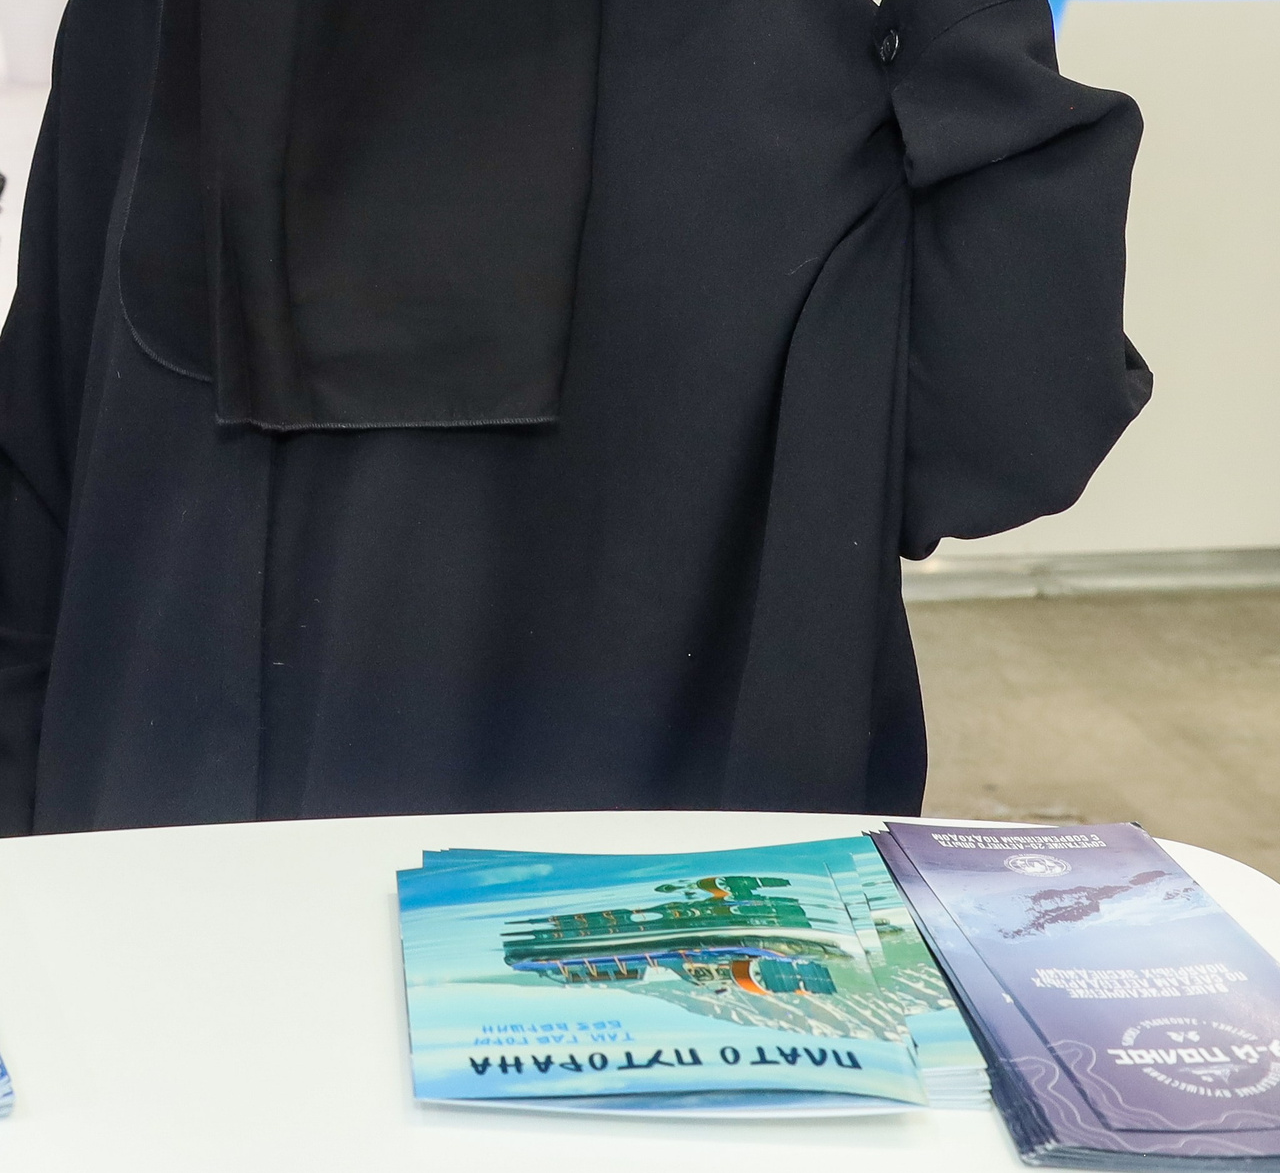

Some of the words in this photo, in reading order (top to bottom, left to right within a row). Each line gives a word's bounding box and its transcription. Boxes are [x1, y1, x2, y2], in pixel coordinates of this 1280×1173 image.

[931, 832, 997, 842] ПОДХОДОМ
[1153, 974, 1224, 988] СЛЕДАМ
[1225, 970, 1248, 982] ПО
[1067, 987, 1181, 999] ПРИКЛЮЧЕНИЕ
[1181, 983, 1229, 996] ВАШЕ
[468, 1048, 703, 1075] ПУТОРАНА
[720, 1046, 863, 1071] ПЛАТО
[1107, 1046, 1231, 1065] ПОЛЮС
